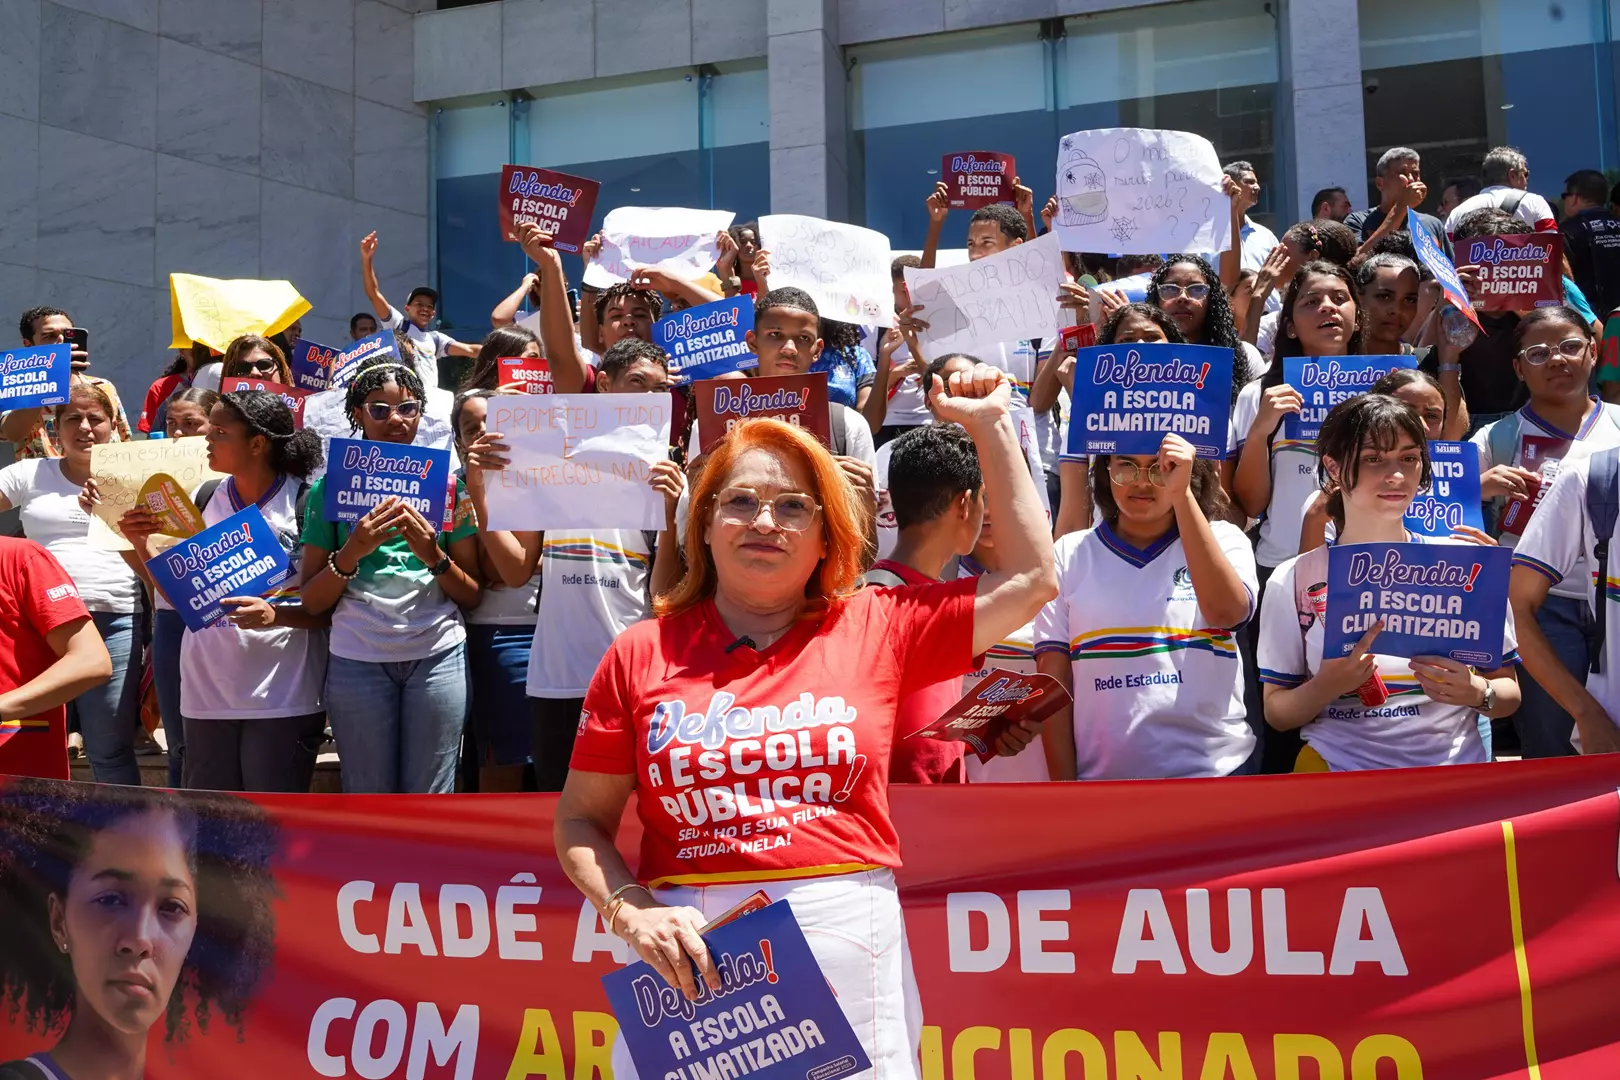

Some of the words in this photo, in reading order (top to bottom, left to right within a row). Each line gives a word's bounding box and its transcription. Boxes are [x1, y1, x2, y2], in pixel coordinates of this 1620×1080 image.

[952, 154, 1006, 175] Defenda!
[509, 171, 582, 207] Defenda!
[958, 175, 965, 185] A
[967, 175, 1001, 186] ESCOLA
[960, 184, 998, 197] PÚBLICA
[512, 198, 521, 211] A
[521, 199, 569, 221] ESCOLA
[1469, 239, 1553, 265] Defenda!
[1479, 267, 1489, 279] A
[1492, 265, 1543, 279] ESCOLA
[1480, 277, 1538, 294] PÚBLICA
[664, 307, 739, 343] Defenda!
[675, 343, 685, 355] A
[687, 329, 736, 350] ESCOLA
[0, 353, 56, 375] efenda!
[315, 368, 324, 378] A
[1093, 350, 1211, 390] Defenda!
[0, 382, 57, 399] MATIZADA
[2, 370, 47, 387] ESCOLA
[714, 384, 809, 417] Defenda!
[1104, 391, 1117, 409] A
[1122, 390, 1196, 411] ESCOLA
[1313, 390, 1324, 405] A
[495, 406, 598, 434] PROMETEU
[614, 405, 663, 426] TUDO
[1086, 413, 1210, 434] CLIMATIZADA
[563, 435, 578, 460] E
[1087, 441, 1116, 450] SINTEPE
[344, 446, 432, 479] Defenda!
[501, 462, 600, 488] ENTREGOU
[611, 461, 650, 483] NAD
[351, 475, 361, 489] A
[365, 476, 420, 495] ESCOLA
[166, 523, 254, 580] Defenda!
[191, 576, 206, 593] A
[203, 547, 258, 584] ESCOLA
[562, 574, 582, 585] Rede
[1348, 549, 1482, 592] Defenda!
[189, 555, 277, 611] CLIMATIZADA
[1359, 591, 1373, 610] A
[1379, 590, 1463, 615] ESCOLA
[1342, 612, 1481, 640] CLIMATIZADA
[1094, 676, 1123, 692] Rede
[1125, 670, 1184, 688] Estadual
[647, 691, 857, 755] Defenda
[1328, 707, 1361, 719] Rede
[649, 762, 663, 788] A
[669, 726, 857, 788] ESCOLA
[659, 753, 868, 827] PÚBLICA!
[678, 827, 700, 842] SEU
[741, 822, 752, 836] E
[755, 816, 790, 833] SUA
[792, 804, 837, 825] FILHA
[740, 833, 792, 853] NELA!
[337, 872, 543, 961] CADÊ
[947, 888, 1077, 975] DE
[1111, 887, 1410, 977] AULA
[307, 997, 480, 1080] COM
[920, 1025, 1424, 1080] ICIONADO
[668, 1030, 691, 1060] A
[689, 993, 786, 1053] ESCOLA
[811, 1065, 833, 1076] Campanha
[832, 1058, 850, 1069] Salarial
